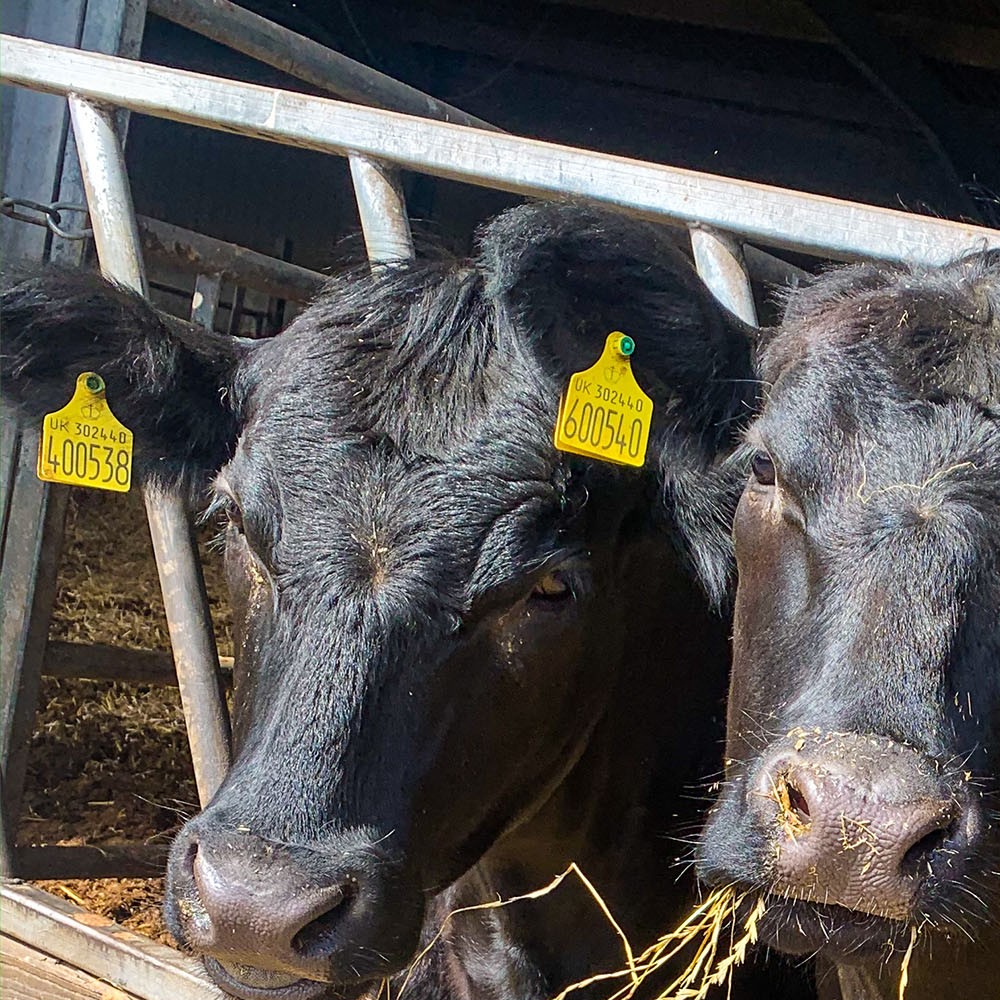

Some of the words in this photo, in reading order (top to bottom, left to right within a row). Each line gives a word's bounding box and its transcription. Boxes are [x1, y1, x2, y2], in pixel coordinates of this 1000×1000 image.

[574, 378, 592, 395] UK
[595, 385, 643, 412] 302440
[50, 418, 69, 432] UK
[75, 422, 127, 444] 302440
[564, 398, 642, 458] 600540
[47, 435, 129, 486] 400538
